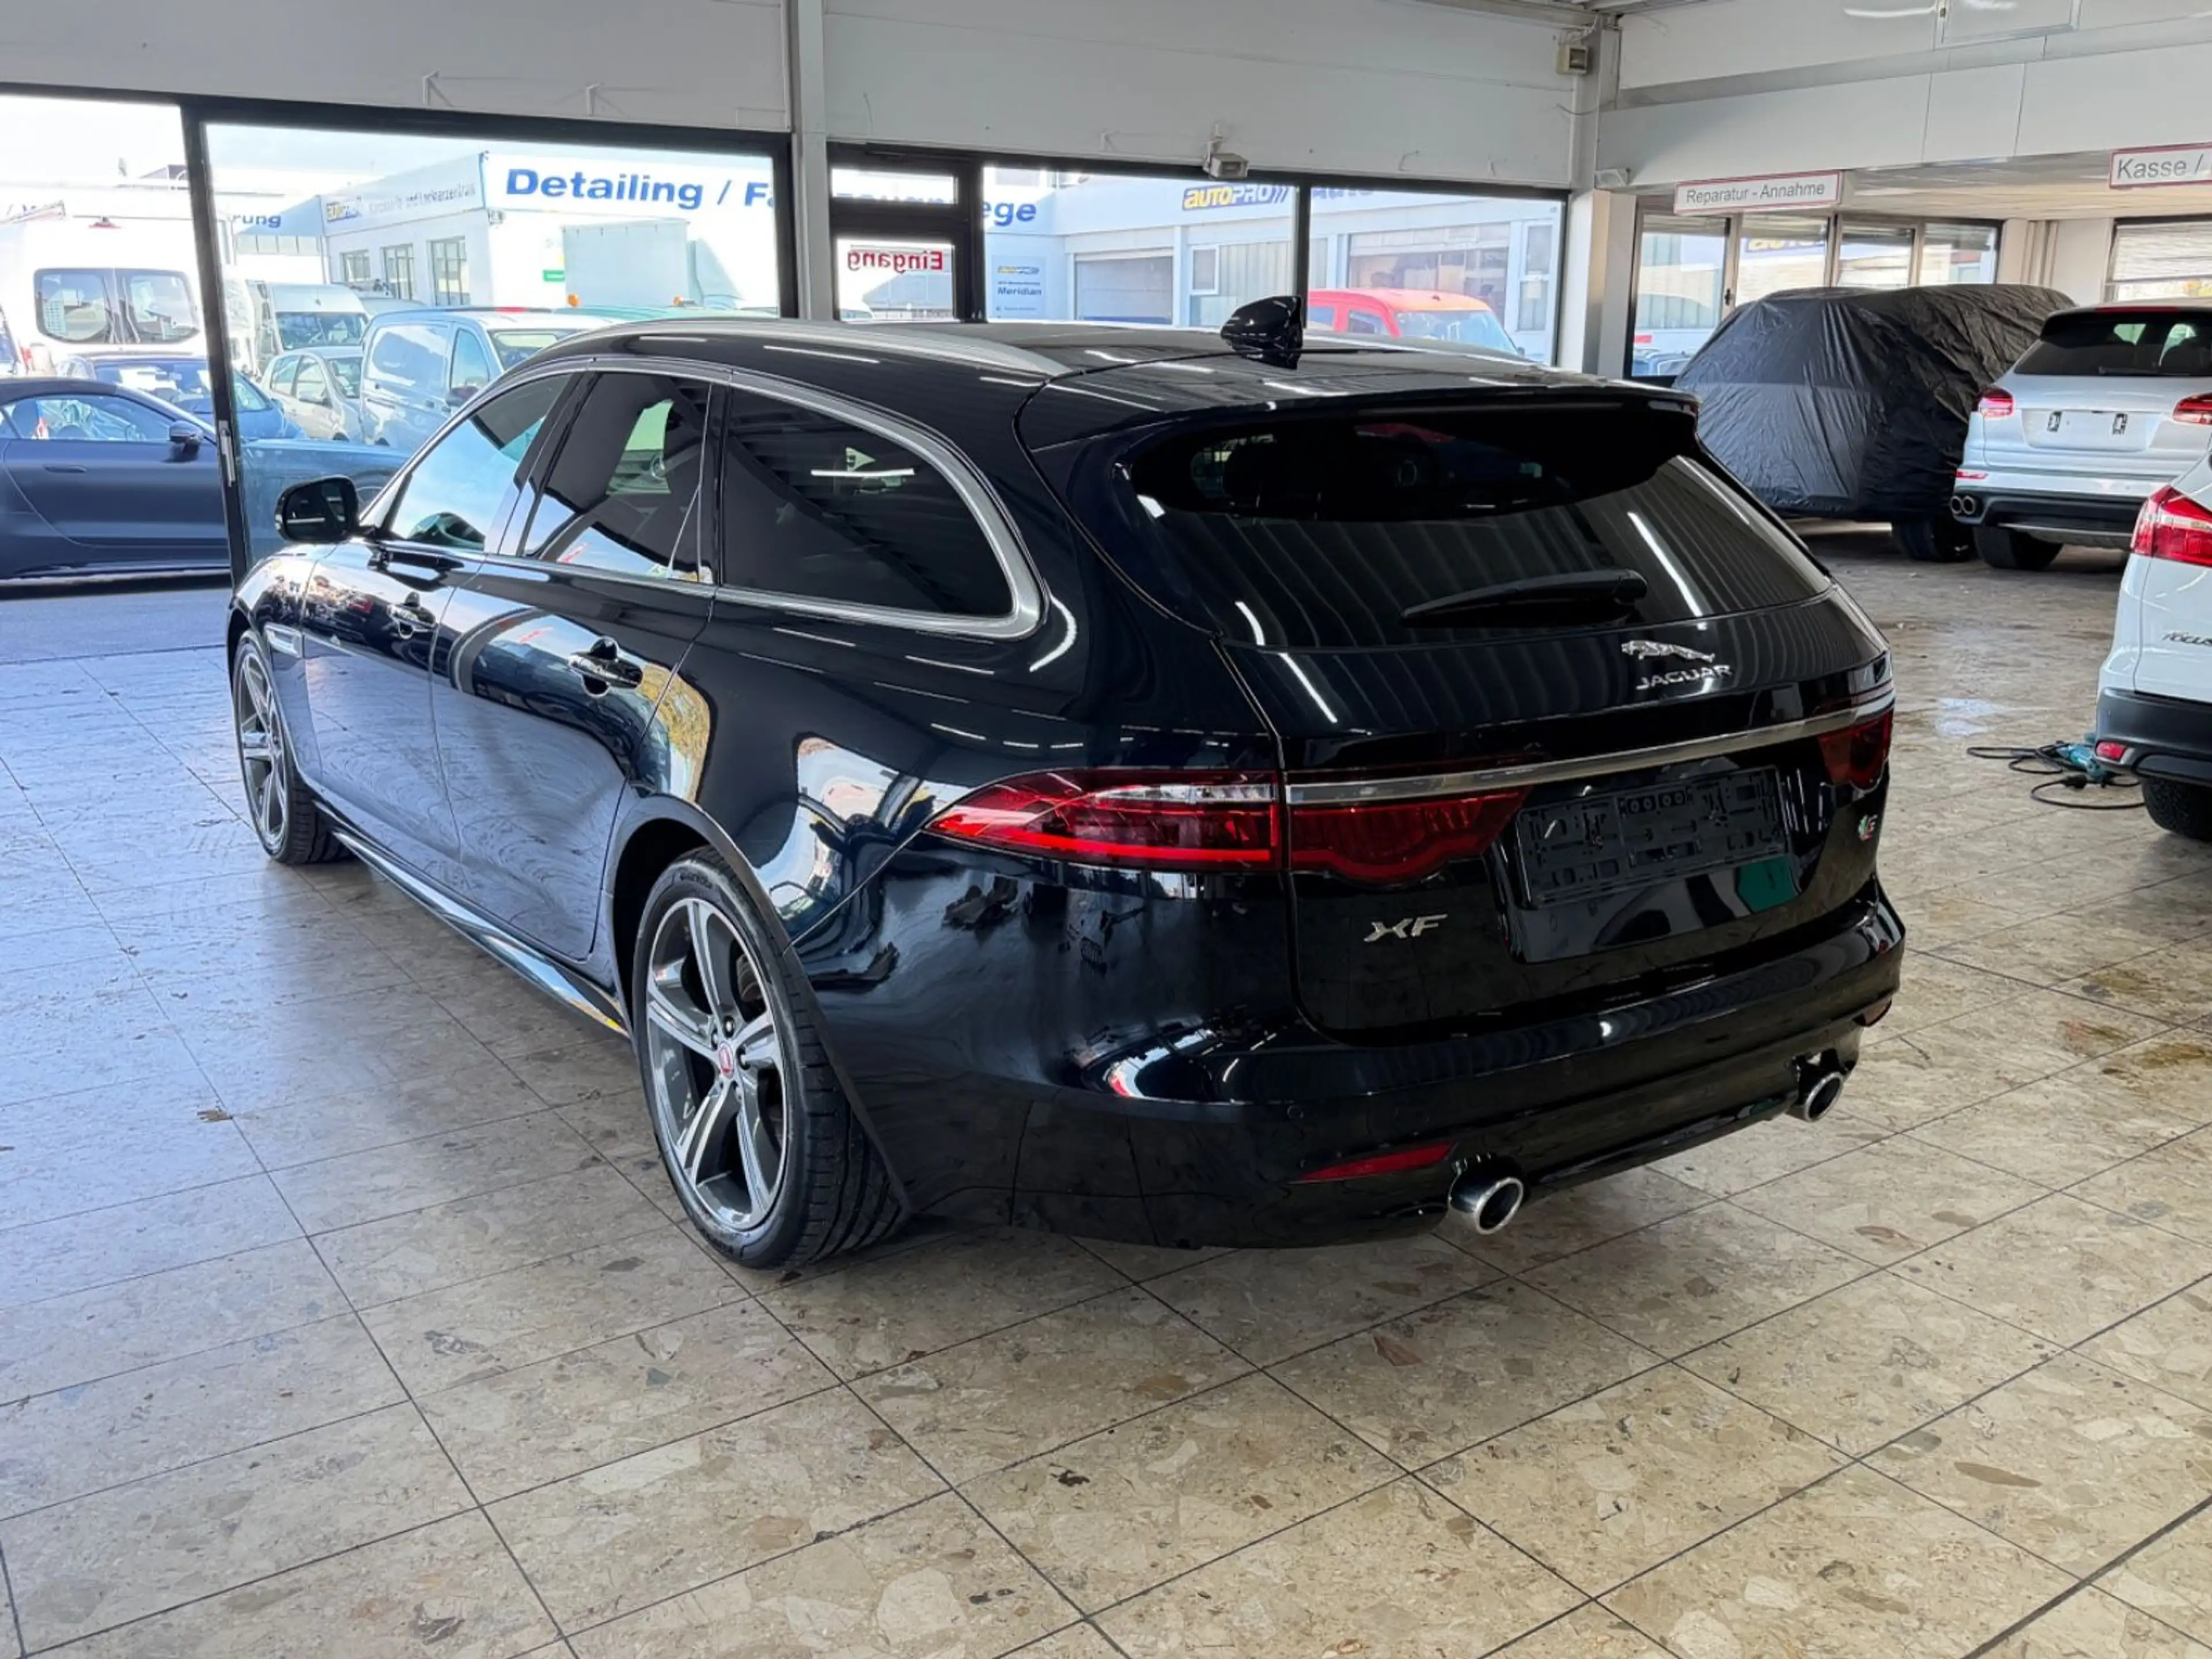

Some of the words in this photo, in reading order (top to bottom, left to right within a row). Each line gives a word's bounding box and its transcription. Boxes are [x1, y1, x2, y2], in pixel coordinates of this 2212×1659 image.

[2117, 158, 2187, 179] Kasse
[506, 168, 703, 210] Detailing
[1686, 188, 1749, 204] Reparatur
[1759, 181, 1825, 199] Annahme
[1635, 664, 1733, 690] JAGUAR
[1363, 913, 1448, 943] XF
